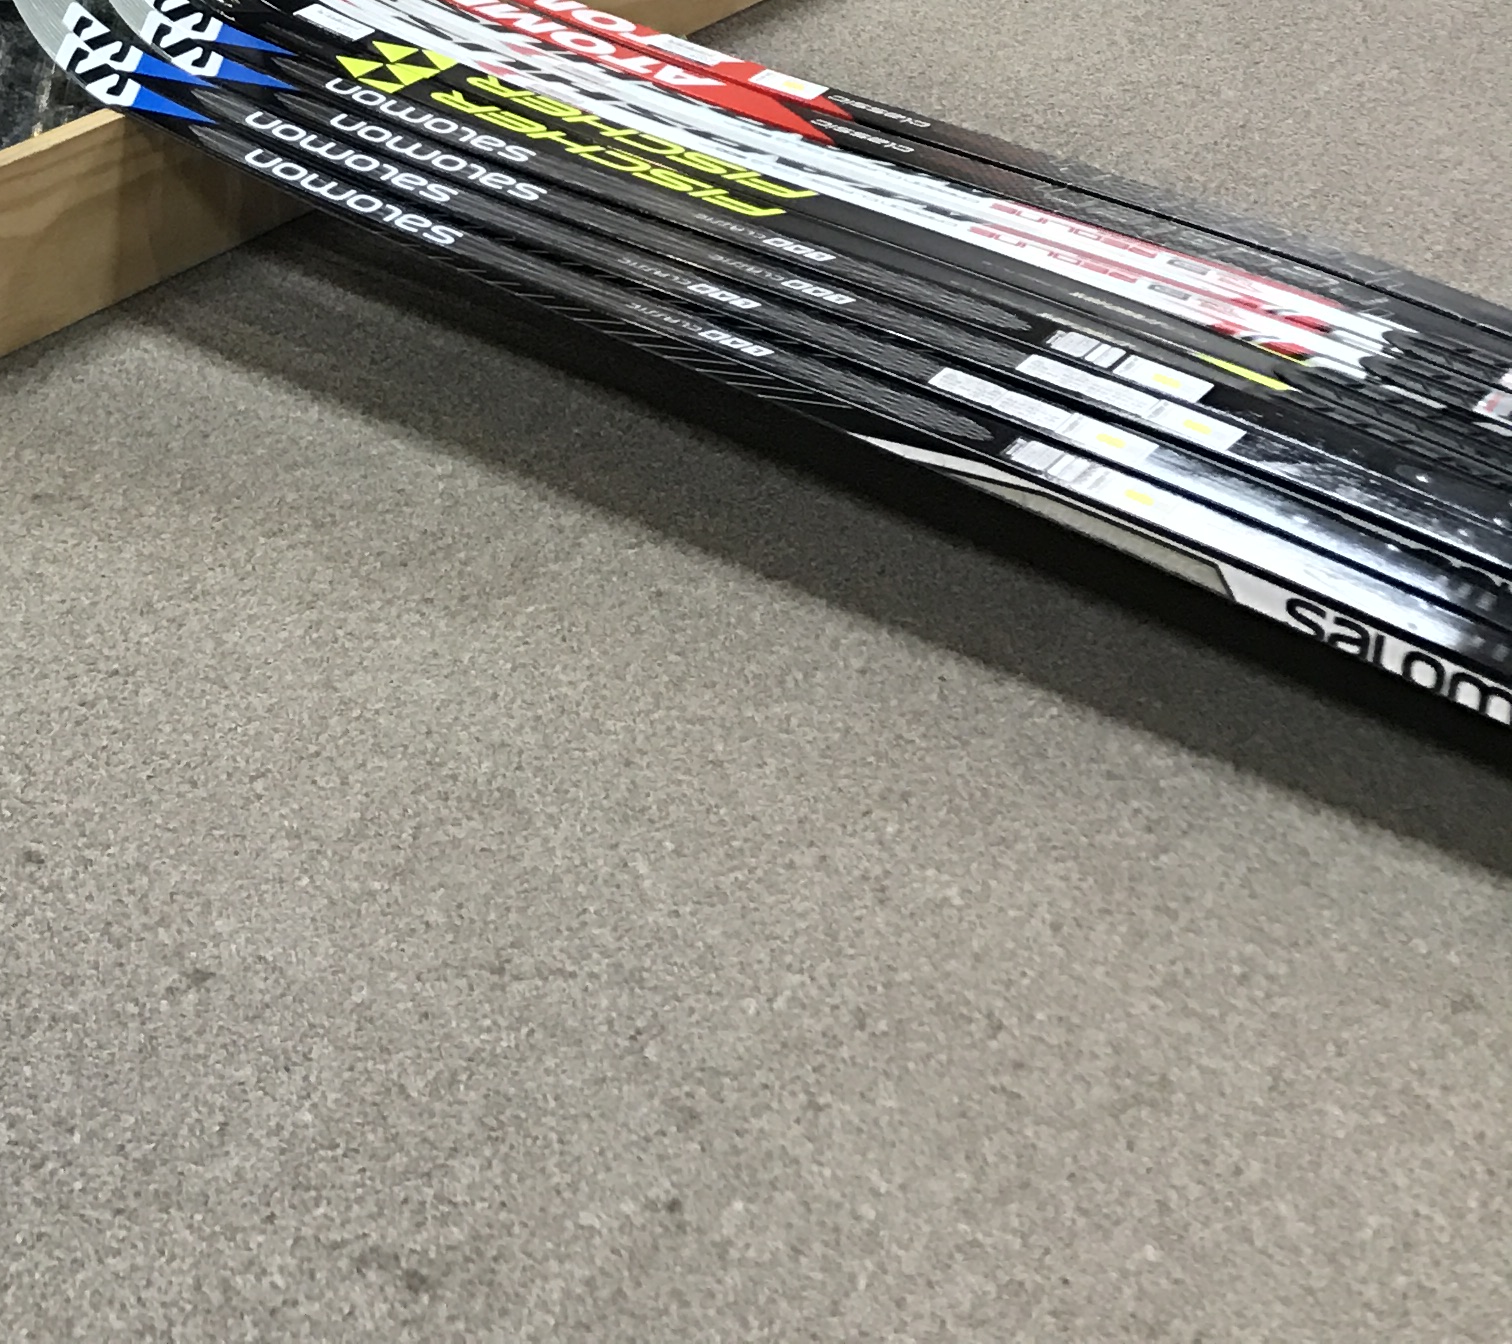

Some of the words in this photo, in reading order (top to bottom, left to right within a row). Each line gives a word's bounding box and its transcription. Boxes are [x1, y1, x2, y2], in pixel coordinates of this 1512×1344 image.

[244, 110, 460, 204] salomon
[324, 77, 538, 164] salomon
[329, 112, 549, 202] salomon
[429, 89, 788, 218] FISCHER
[466, 75, 818, 199] FISCHER
[810, 118, 915, 155] classic
[828, 93, 931, 129] classic
[243, 147, 464, 247] salomon
